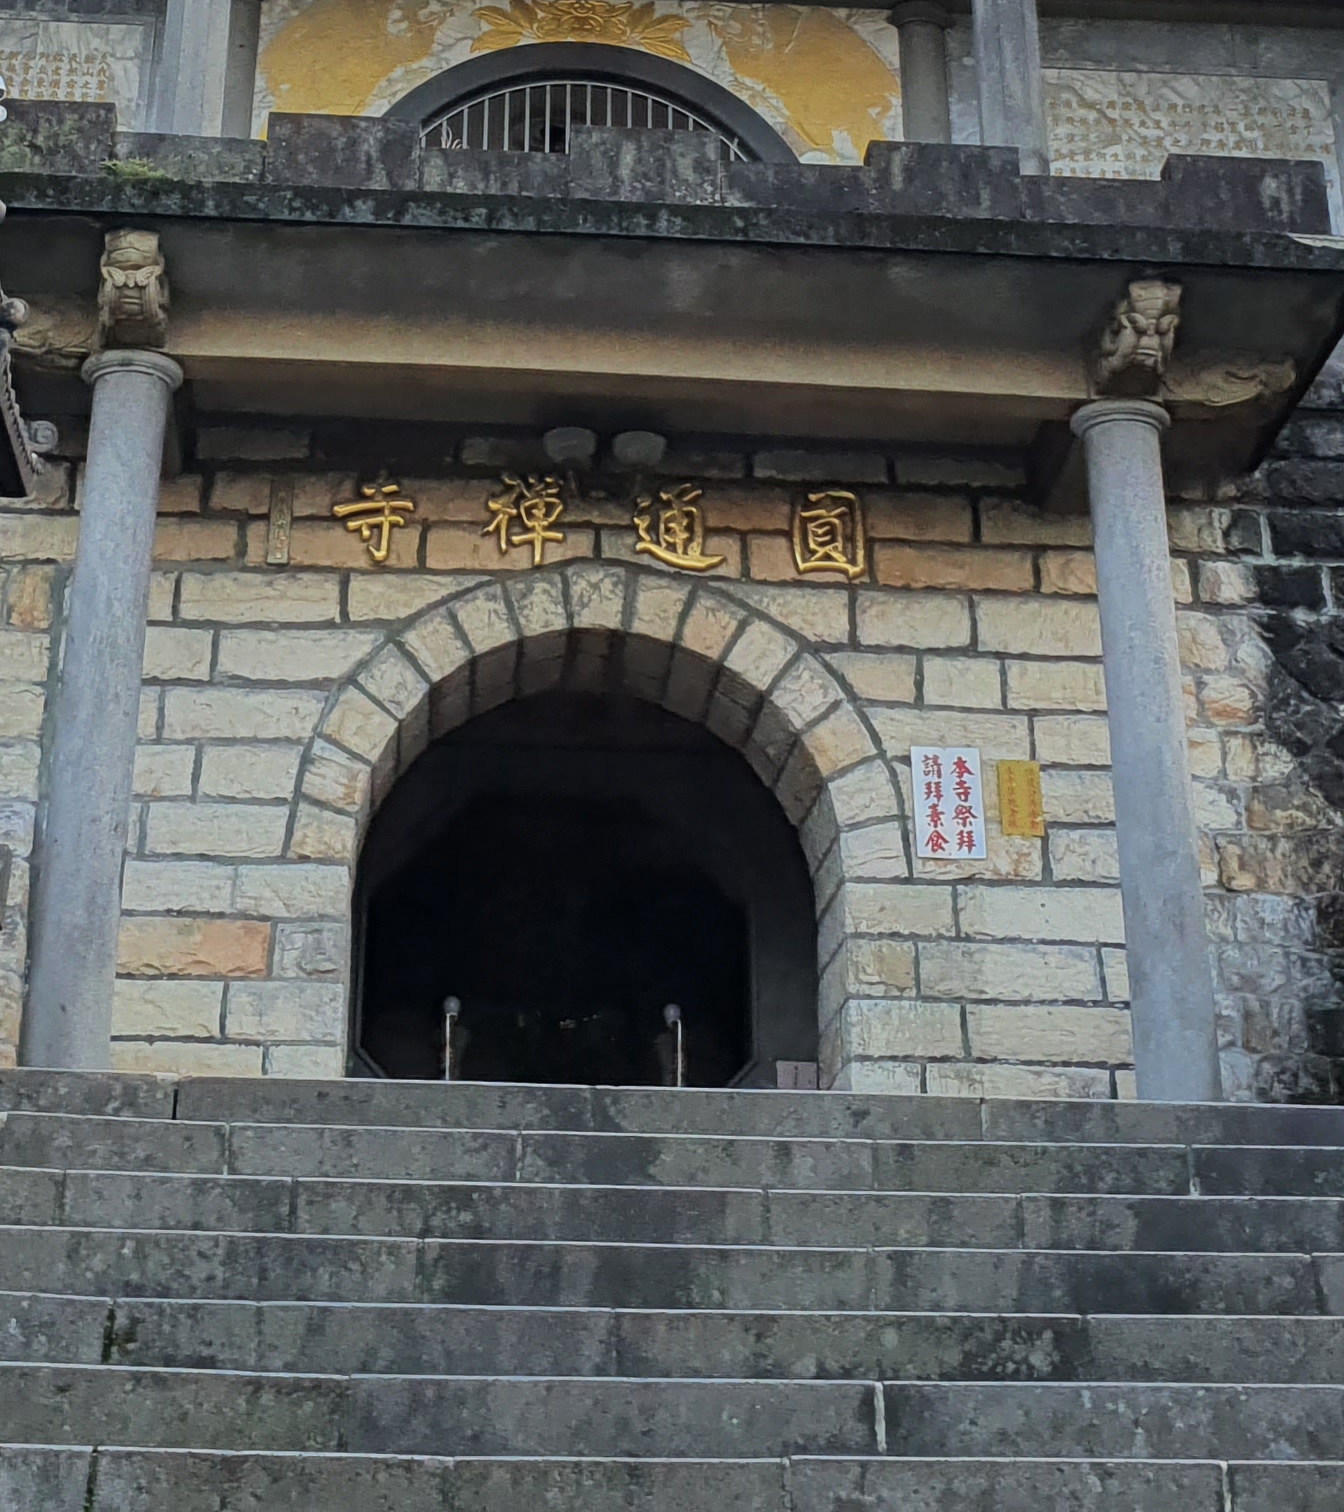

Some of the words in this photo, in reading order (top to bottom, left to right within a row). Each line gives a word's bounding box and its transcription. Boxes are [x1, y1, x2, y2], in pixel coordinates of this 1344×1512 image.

[333, 473, 866, 578] 圓通禪寺
[921, 755, 949, 853] 請拜素食
[950, 757, 978, 854] 本寺祭拜
